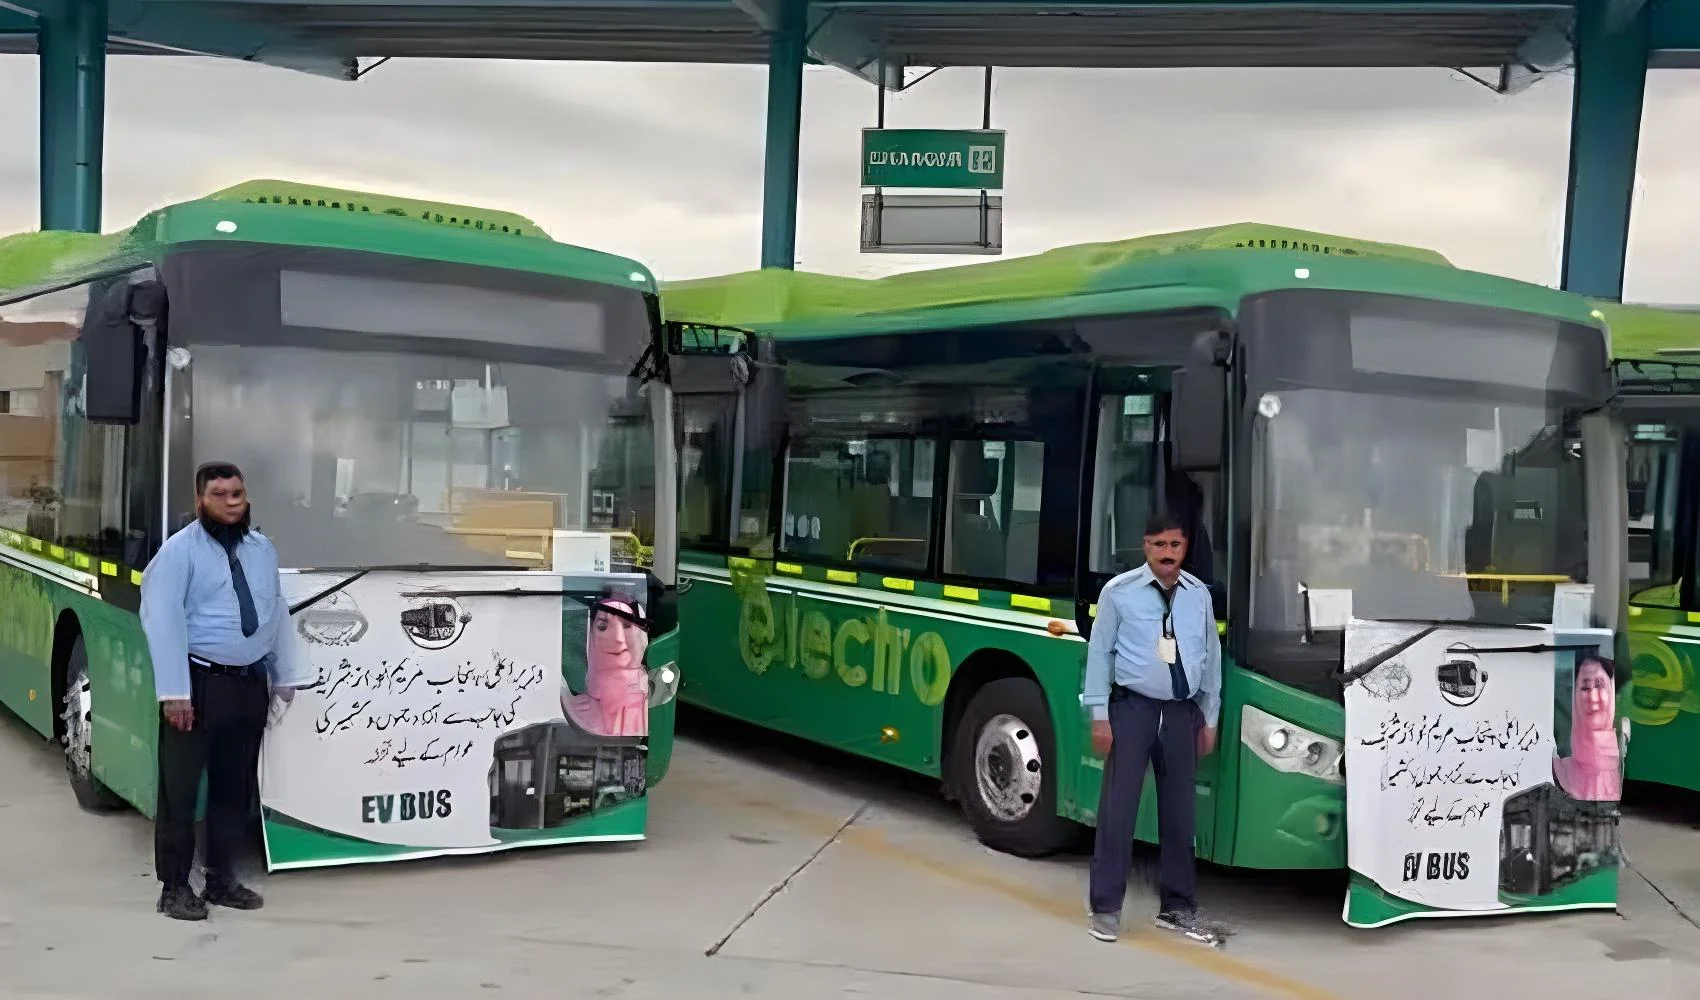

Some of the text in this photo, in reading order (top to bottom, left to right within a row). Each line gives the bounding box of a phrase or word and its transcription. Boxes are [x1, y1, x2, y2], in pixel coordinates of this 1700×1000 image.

[362, 789, 452, 824] EV BUS
[1427, 851, 1470, 880] BUS
